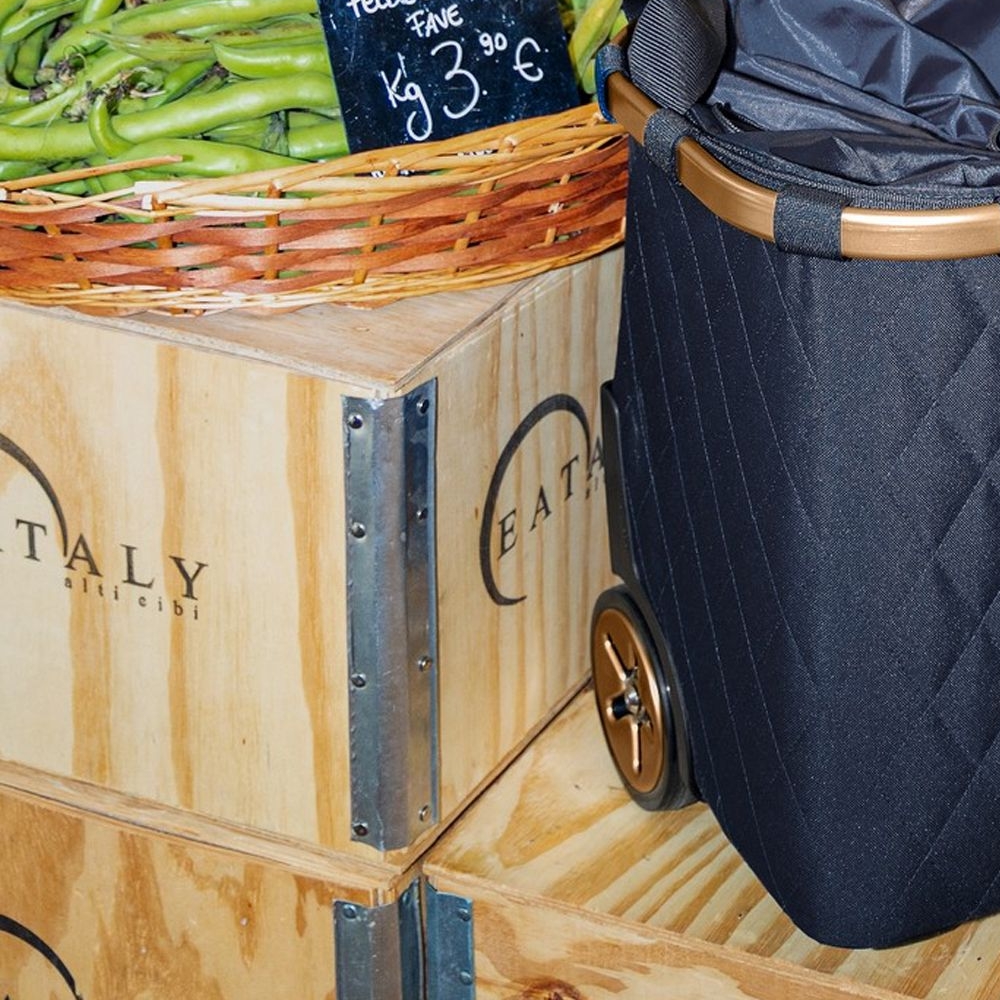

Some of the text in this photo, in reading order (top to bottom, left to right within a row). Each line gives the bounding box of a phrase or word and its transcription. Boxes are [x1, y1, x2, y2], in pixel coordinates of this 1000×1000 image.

[406, 4, 463, 38] FAVE
[378, 52, 432, 141] Kg
[513, 37, 544, 82] €
[1, 515, 209, 601] TALY
